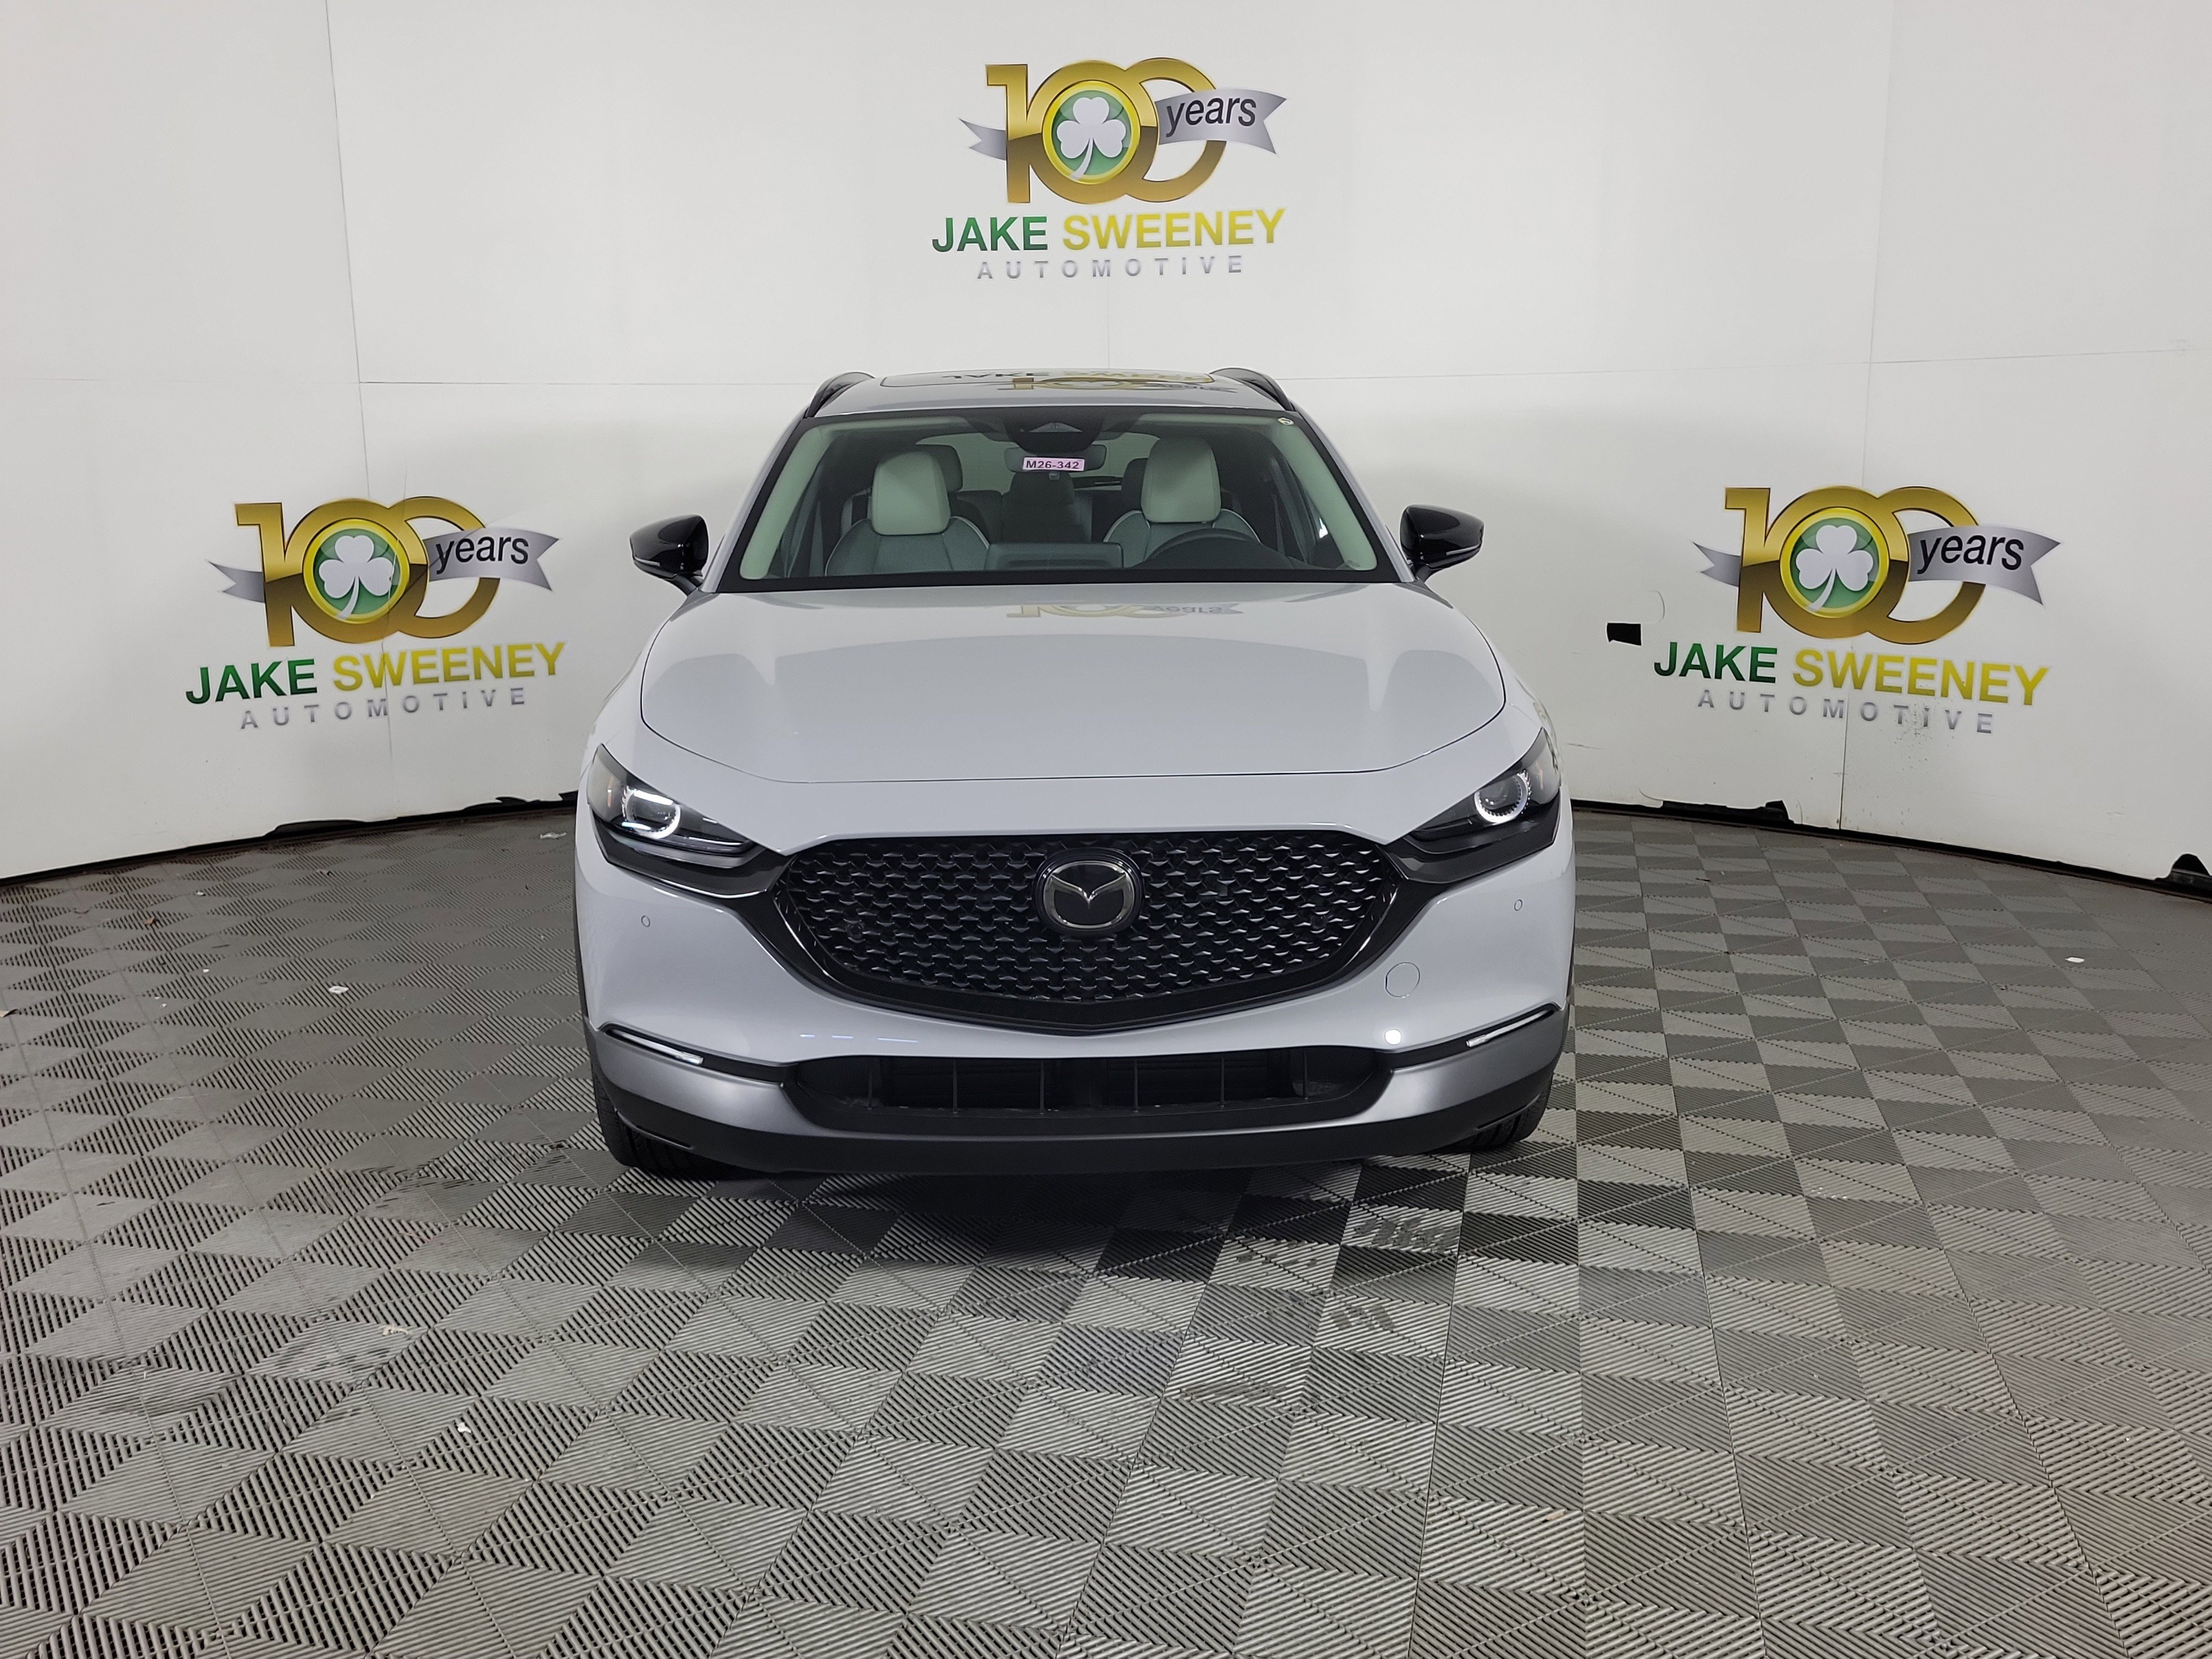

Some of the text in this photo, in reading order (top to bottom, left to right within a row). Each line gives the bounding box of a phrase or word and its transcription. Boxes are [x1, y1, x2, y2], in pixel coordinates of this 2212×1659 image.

[1166, 95, 1257, 137] years
[932, 208, 1285, 252] JAKE SWEENEY
[977, 255, 1242, 280] AUTOMOTIVE
[1026, 460, 1079, 469] M26-342
[436, 534, 529, 574] years
[1917, 534, 2025, 575] years
[185, 642, 566, 705] JAKE SWEENEY
[1654, 641, 2049, 706] JAKE SWEENEY
[240, 687, 525, 730] AUTOMOTIVE
[1698, 689, 1993, 734] AUTOMOTIVE
